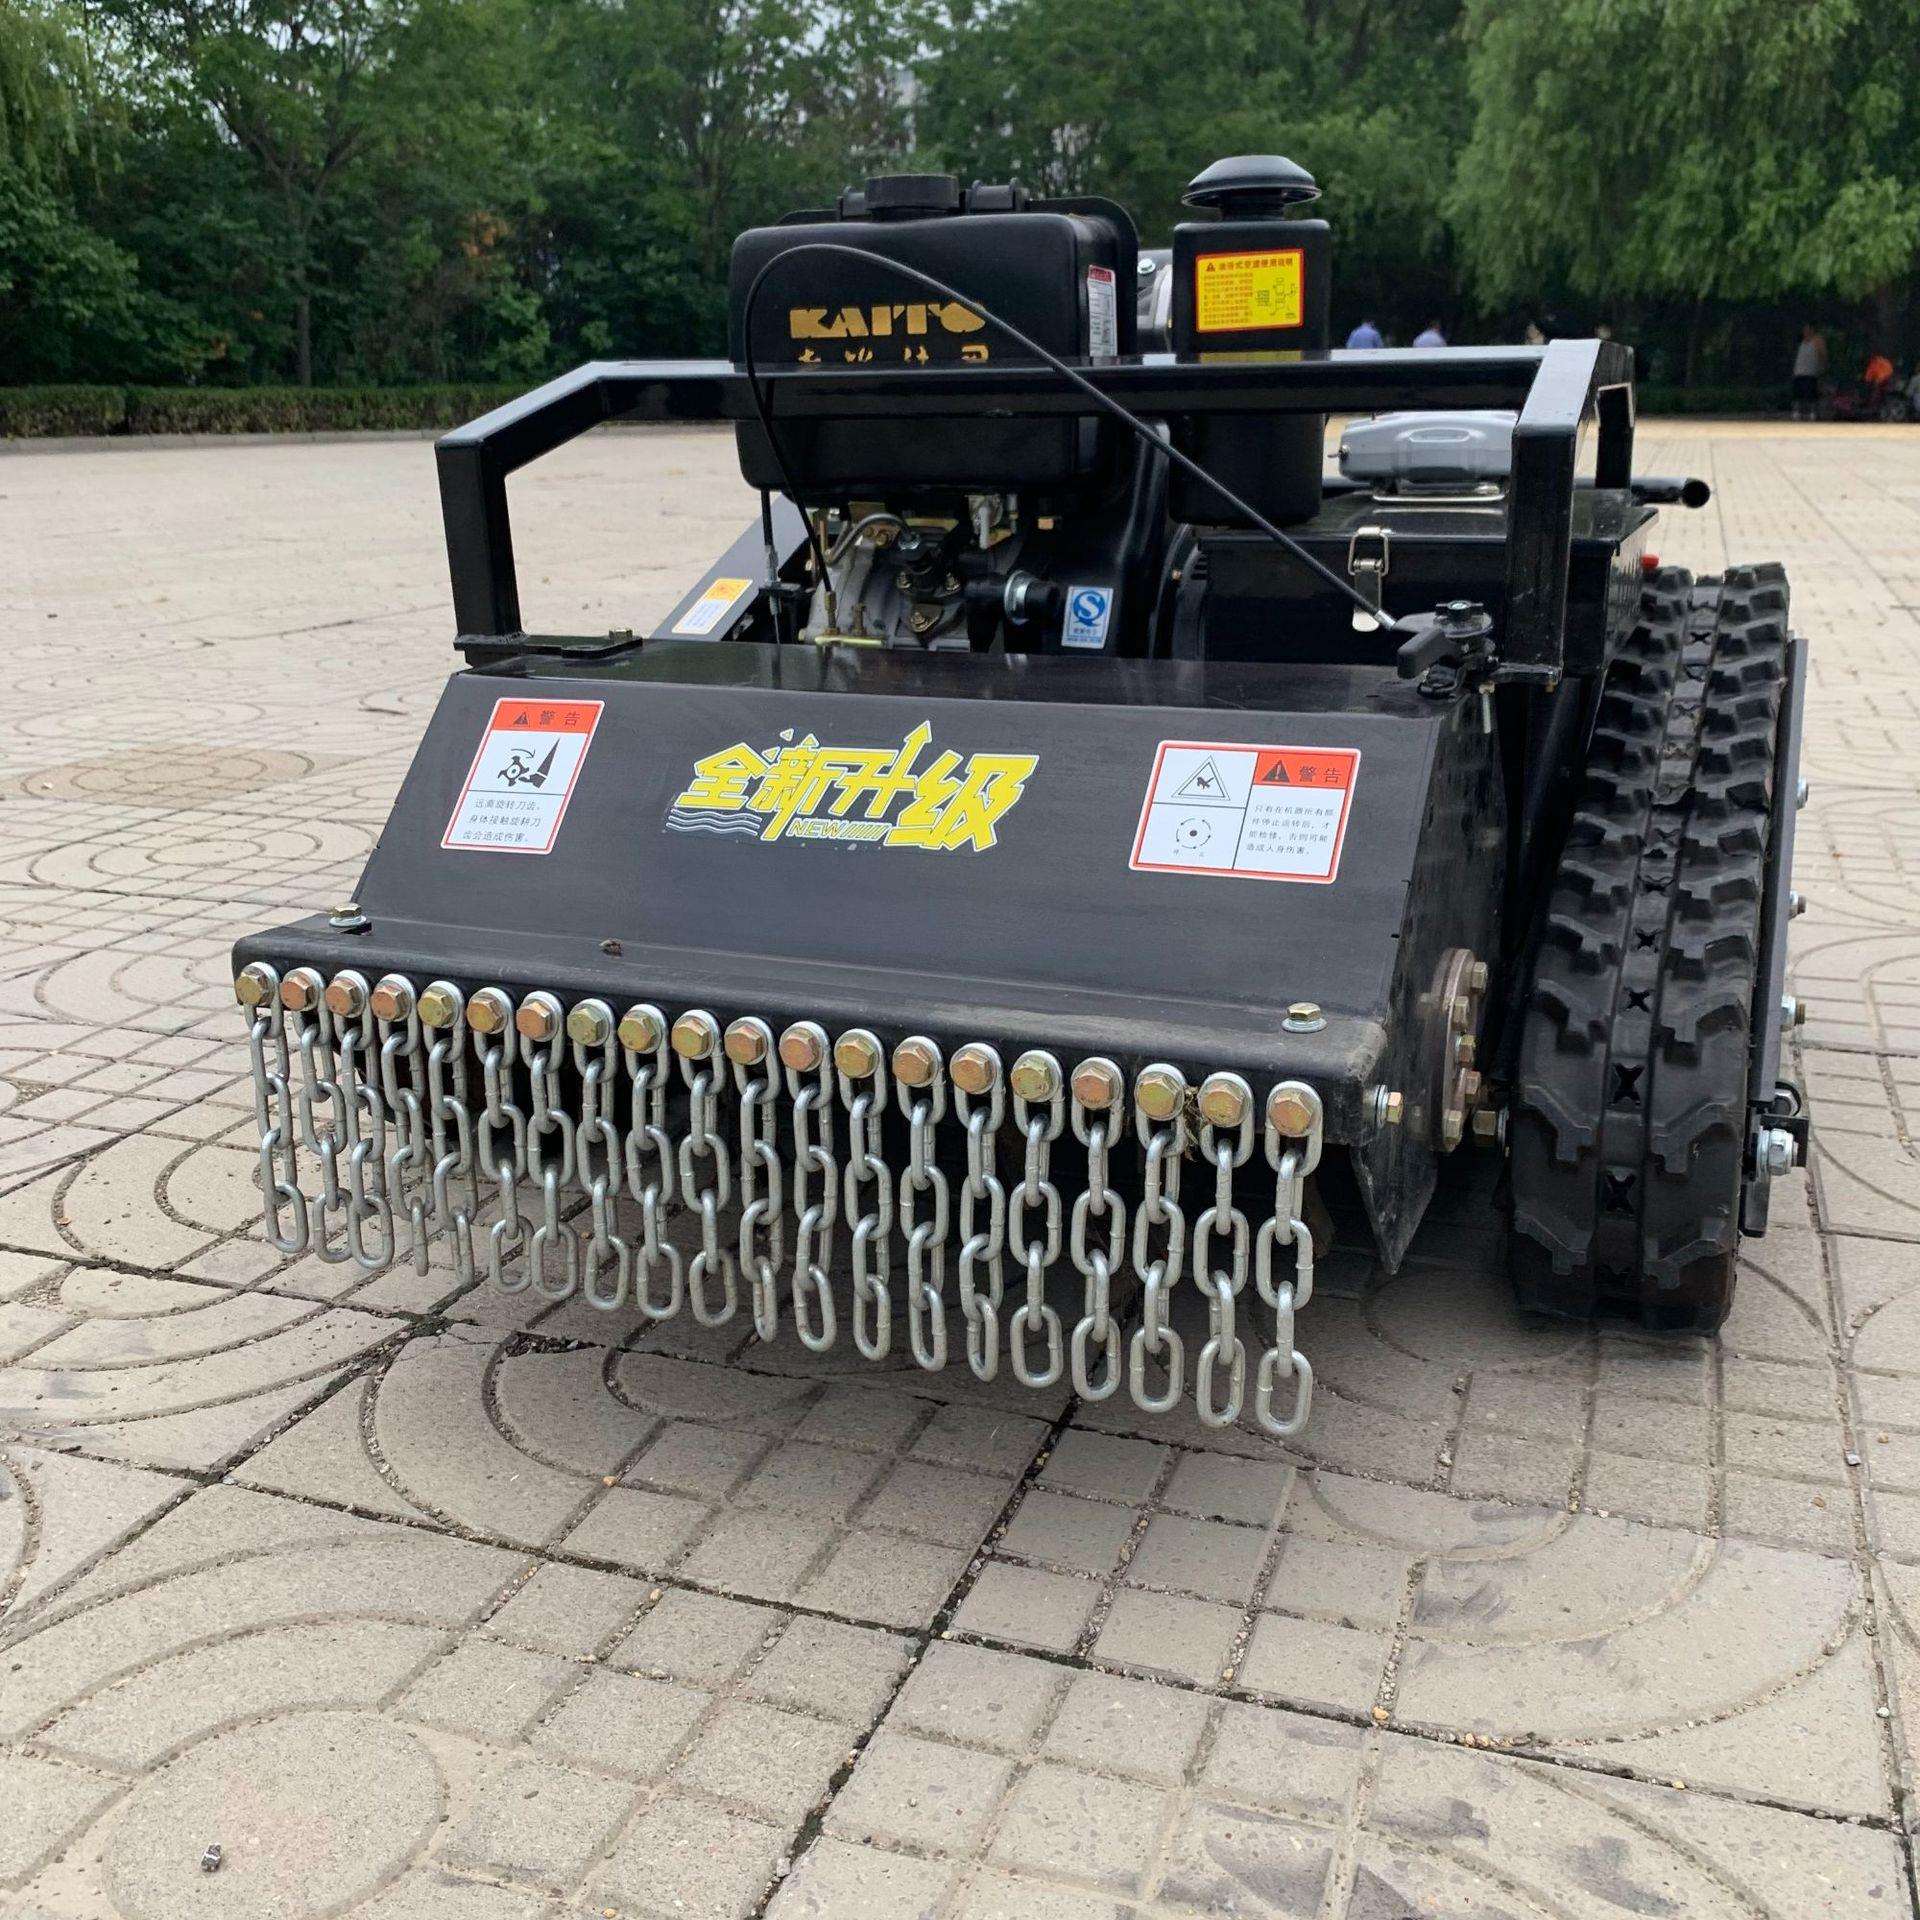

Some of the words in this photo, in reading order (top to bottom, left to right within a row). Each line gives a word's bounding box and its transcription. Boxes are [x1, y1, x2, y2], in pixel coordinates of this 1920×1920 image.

[539, 710, 580, 728] 警告
[1298, 765, 1341, 785] 警告
[673, 719, 1040, 852] 全新升级
